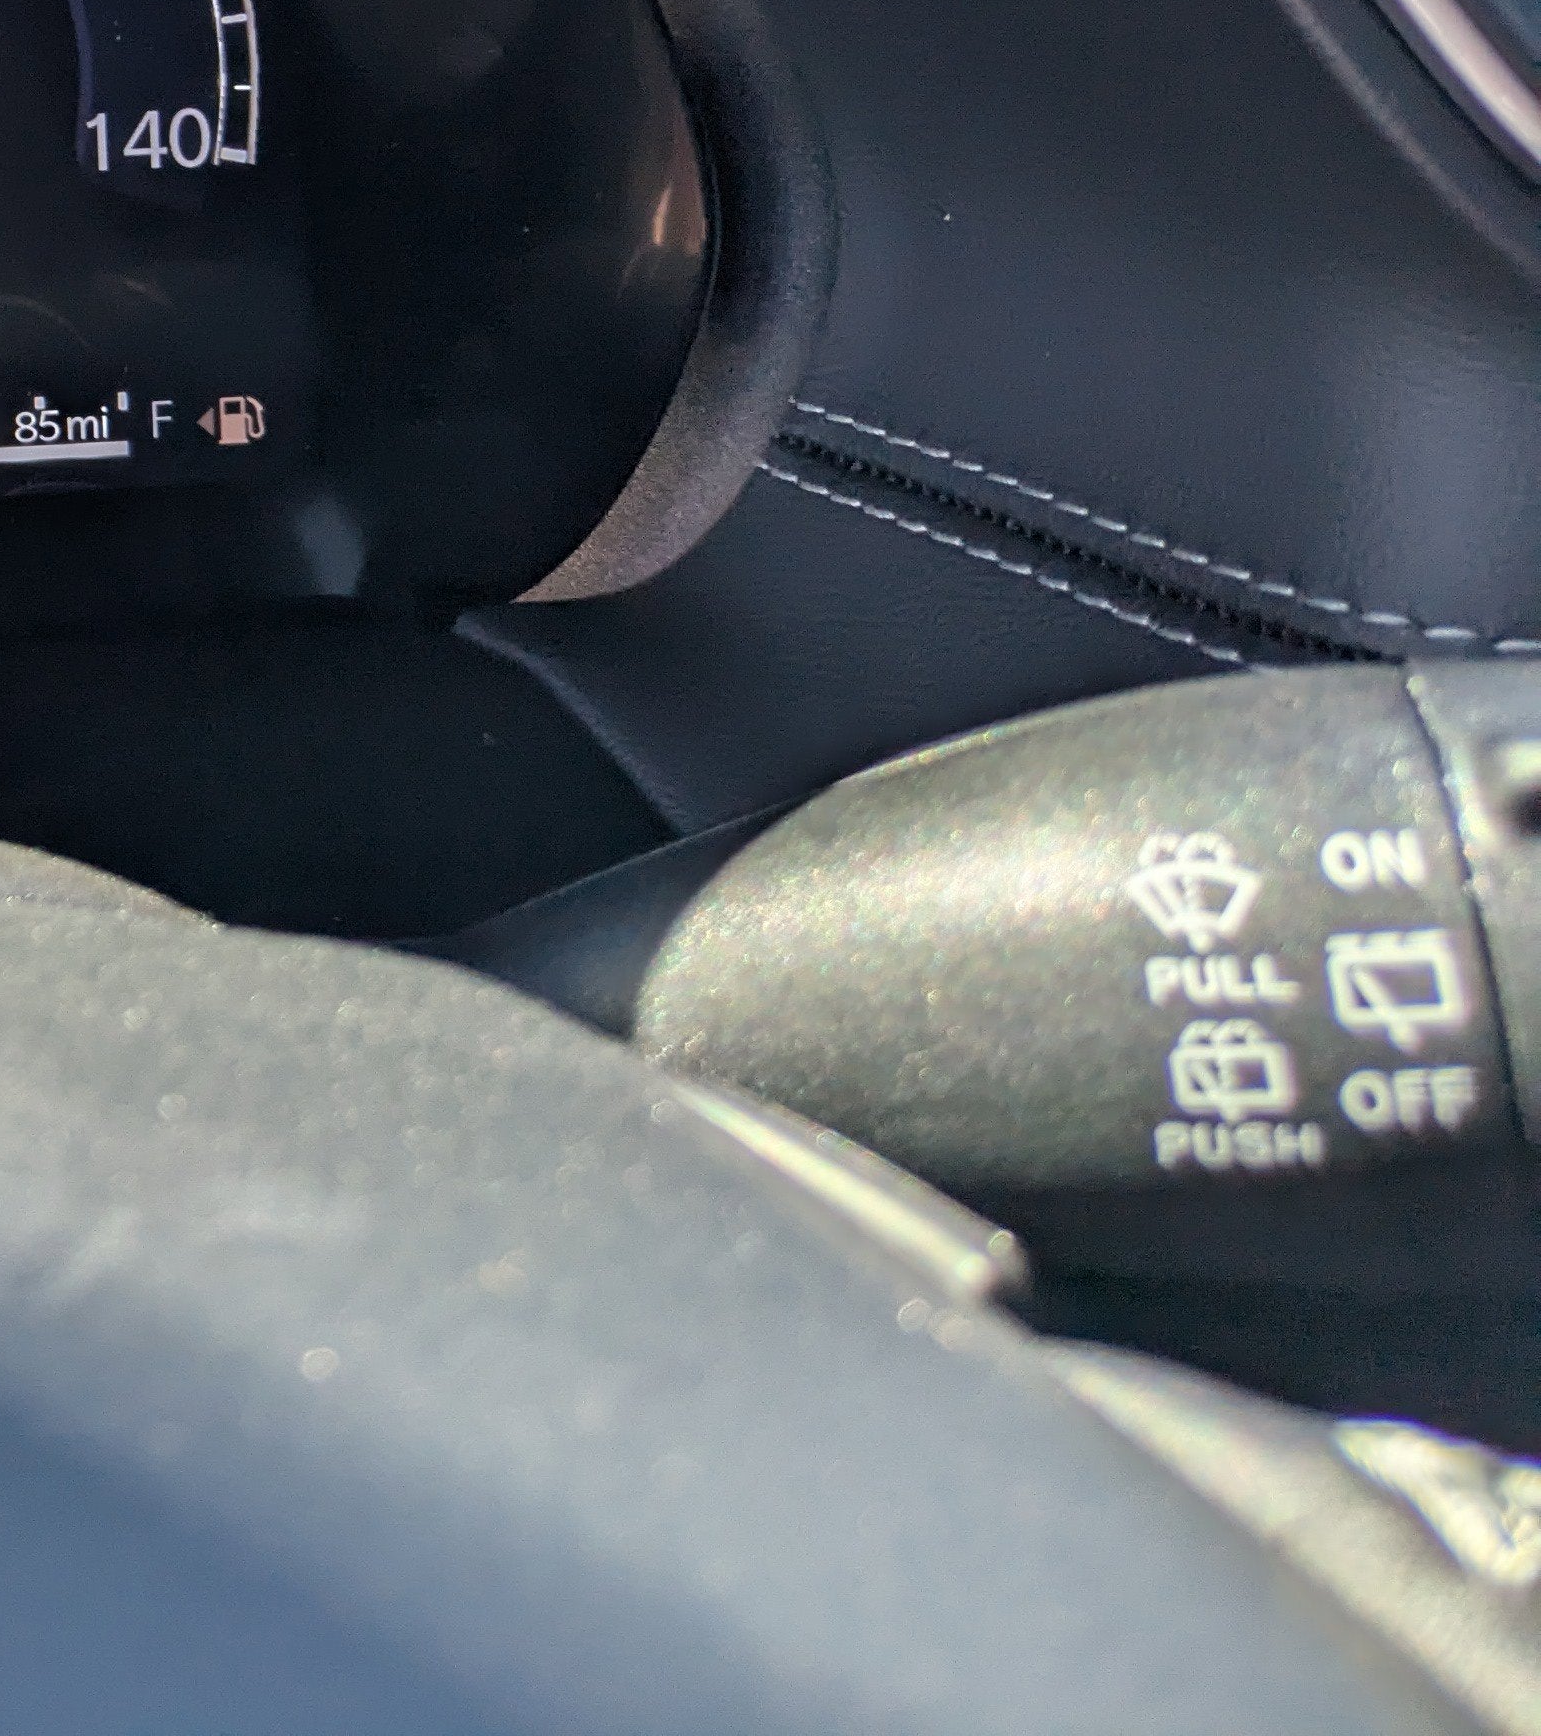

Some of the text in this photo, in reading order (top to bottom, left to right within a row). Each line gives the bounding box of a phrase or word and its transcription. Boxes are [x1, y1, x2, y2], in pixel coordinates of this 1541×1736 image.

[85, 108, 212, 172] 140
[13, 405, 111, 443] 85mi
[151, 399, 174, 440] F
[1320, 829, 1424, 892] ON
[1144, 953, 1301, 1008] PULL
[1339, 1067, 1476, 1132] OFF
[1153, 1120, 1326, 1170] PUSH
